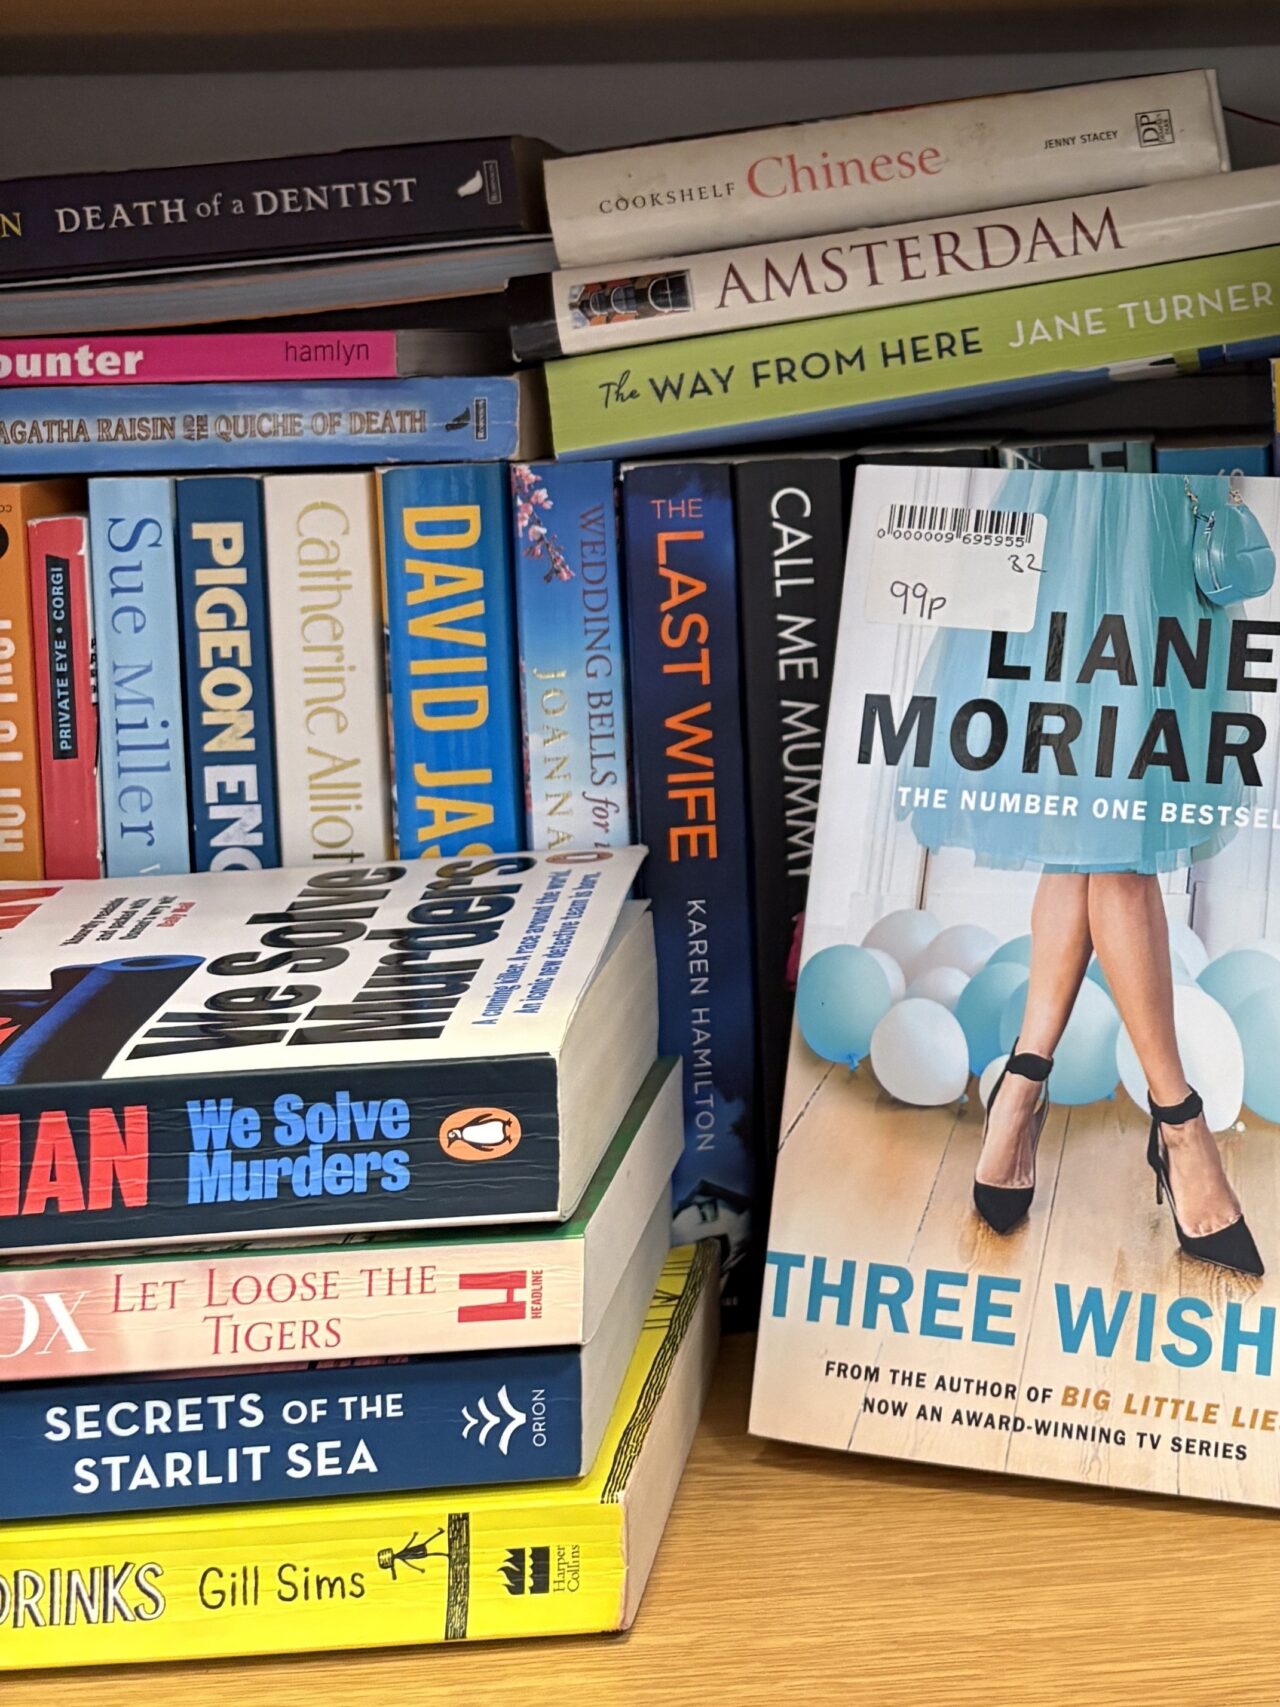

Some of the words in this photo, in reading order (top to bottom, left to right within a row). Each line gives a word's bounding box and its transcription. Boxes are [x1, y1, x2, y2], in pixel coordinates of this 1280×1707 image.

[1044, 136, 1076, 149] JENNY
[1080, 130, 1118, 144] STACEY
[1139, 114, 1160, 143] DP
[55, 198, 188, 233] DEATH
[196, 193, 223, 218] of
[232, 196, 245, 215] a
[253, 177, 416, 216] DENTIST
[599, 182, 735, 213] COOKSHELF
[747, 146, 942, 198] Chinese
[715, 206, 1127, 309] AMSTERDAM
[1009, 308, 1107, 350] JANE
[1118, 281, 1274, 326] TURNER
[285, 340, 370, 363] hamlyn
[599, 369, 641, 409] The
[649, 365, 735, 403] WAY
[752, 346, 865, 389] FROM
[880, 326, 983, 368] HERE
[0, 418, 90, 444] AGATHA
[97, 416, 176, 442] RAISIN
[216, 413, 302, 442] QUICHE
[311, 412, 341, 437] OF
[349, 409, 426, 436] DEATH
[651, 498, 704, 519] THE
[771, 487, 814, 597] CALL
[877, 528, 886, 539] 0
[963, 533, 1025, 548] 695955
[51, 567, 64, 620] CORGI
[108, 517, 163, 635] Sue
[580, 502, 613, 679] WEDDING
[890, 580, 947, 620] 99p
[191, 521, 256, 752] PIGEON
[297, 501, 357, 736] Catherine
[402, 504, 489, 732] DAVID
[656, 530, 711, 686] LAST
[54, 638, 68, 673] EYE
[776, 613, 819, 681] ME
[55, 677, 73, 751] PRIVATE
[586, 690, 618, 788] BELLS
[112, 661, 171, 847] Miller
[532, 666, 575, 851] JOANNA
[664, 702, 718, 863] WIFE
[582, 790, 620, 834] for
[780, 700, 822, 877] MUMMY
[899, 786, 948, 810] THE
[960, 789, 1078, 818] NUMBER
[1092, 798, 1148, 822] ONE
[206, 866, 406, 977] Solve
[526, 905, 554, 934] around
[536, 891, 561, 904] the
[560, 899, 589, 919] team
[285, 856, 538, 1046] Murders
[516, 935, 541, 954] race
[539, 960, 564, 976] new
[542, 921, 580, 958] detective
[686, 899, 710, 995] KAREN
[482, 984, 521, 1017] cunning
[494, 963, 528, 985] killer.
[520, 978, 554, 1001] iconic
[126, 985, 319, 1061] We
[513, 1003, 543, 1013] An
[691, 1008, 716, 1151] HAMILTON
[186, 1095, 261, 1152] We
[273, 1091, 411, 1148] Solve
[0, 1105, 148, 1217] AN
[187, 1144, 411, 1206] Murders
[113, 1273, 187, 1314] LET
[203, 1267, 341, 1309] LOOSE
[360, 1264, 437, 1298] THE
[531, 1269, 543, 1319] HEADLINE
[766, 1251, 1021, 1346] THREE
[203, 1315, 342, 1356] TIGERS
[45, 1393, 265, 1442] SECRETS
[282, 1399, 328, 1425] OF
[338, 1393, 404, 1420] THE
[533, 1388, 546, 1448] ORION
[825, 1360, 881, 1384] FROM
[888, 1367, 927, 1389] THE
[935, 1374, 1017, 1401] AUTHOR
[1026, 1385, 1053, 1405] OF
[1061, 1385, 1112, 1412] BIG
[1122, 1393, 1219, 1425] LITTLE
[862, 1397, 909, 1418] NOW
[916, 1402, 943, 1423] AN
[952, 1407, 1126, 1447] AWARD-WINNING
[1137, 1432, 1162, 1450] TV
[1170, 1435, 1249, 1462] SERIES
[72, 1445, 271, 1495] STARLIT
[287, 1438, 379, 1479] SEA
[198, 1566, 260, 1612] Gill
[277, 1564, 365, 1602] Sims
[553, 1545, 569, 1592] Harper
[567, 1545, 580, 1592] Collins
